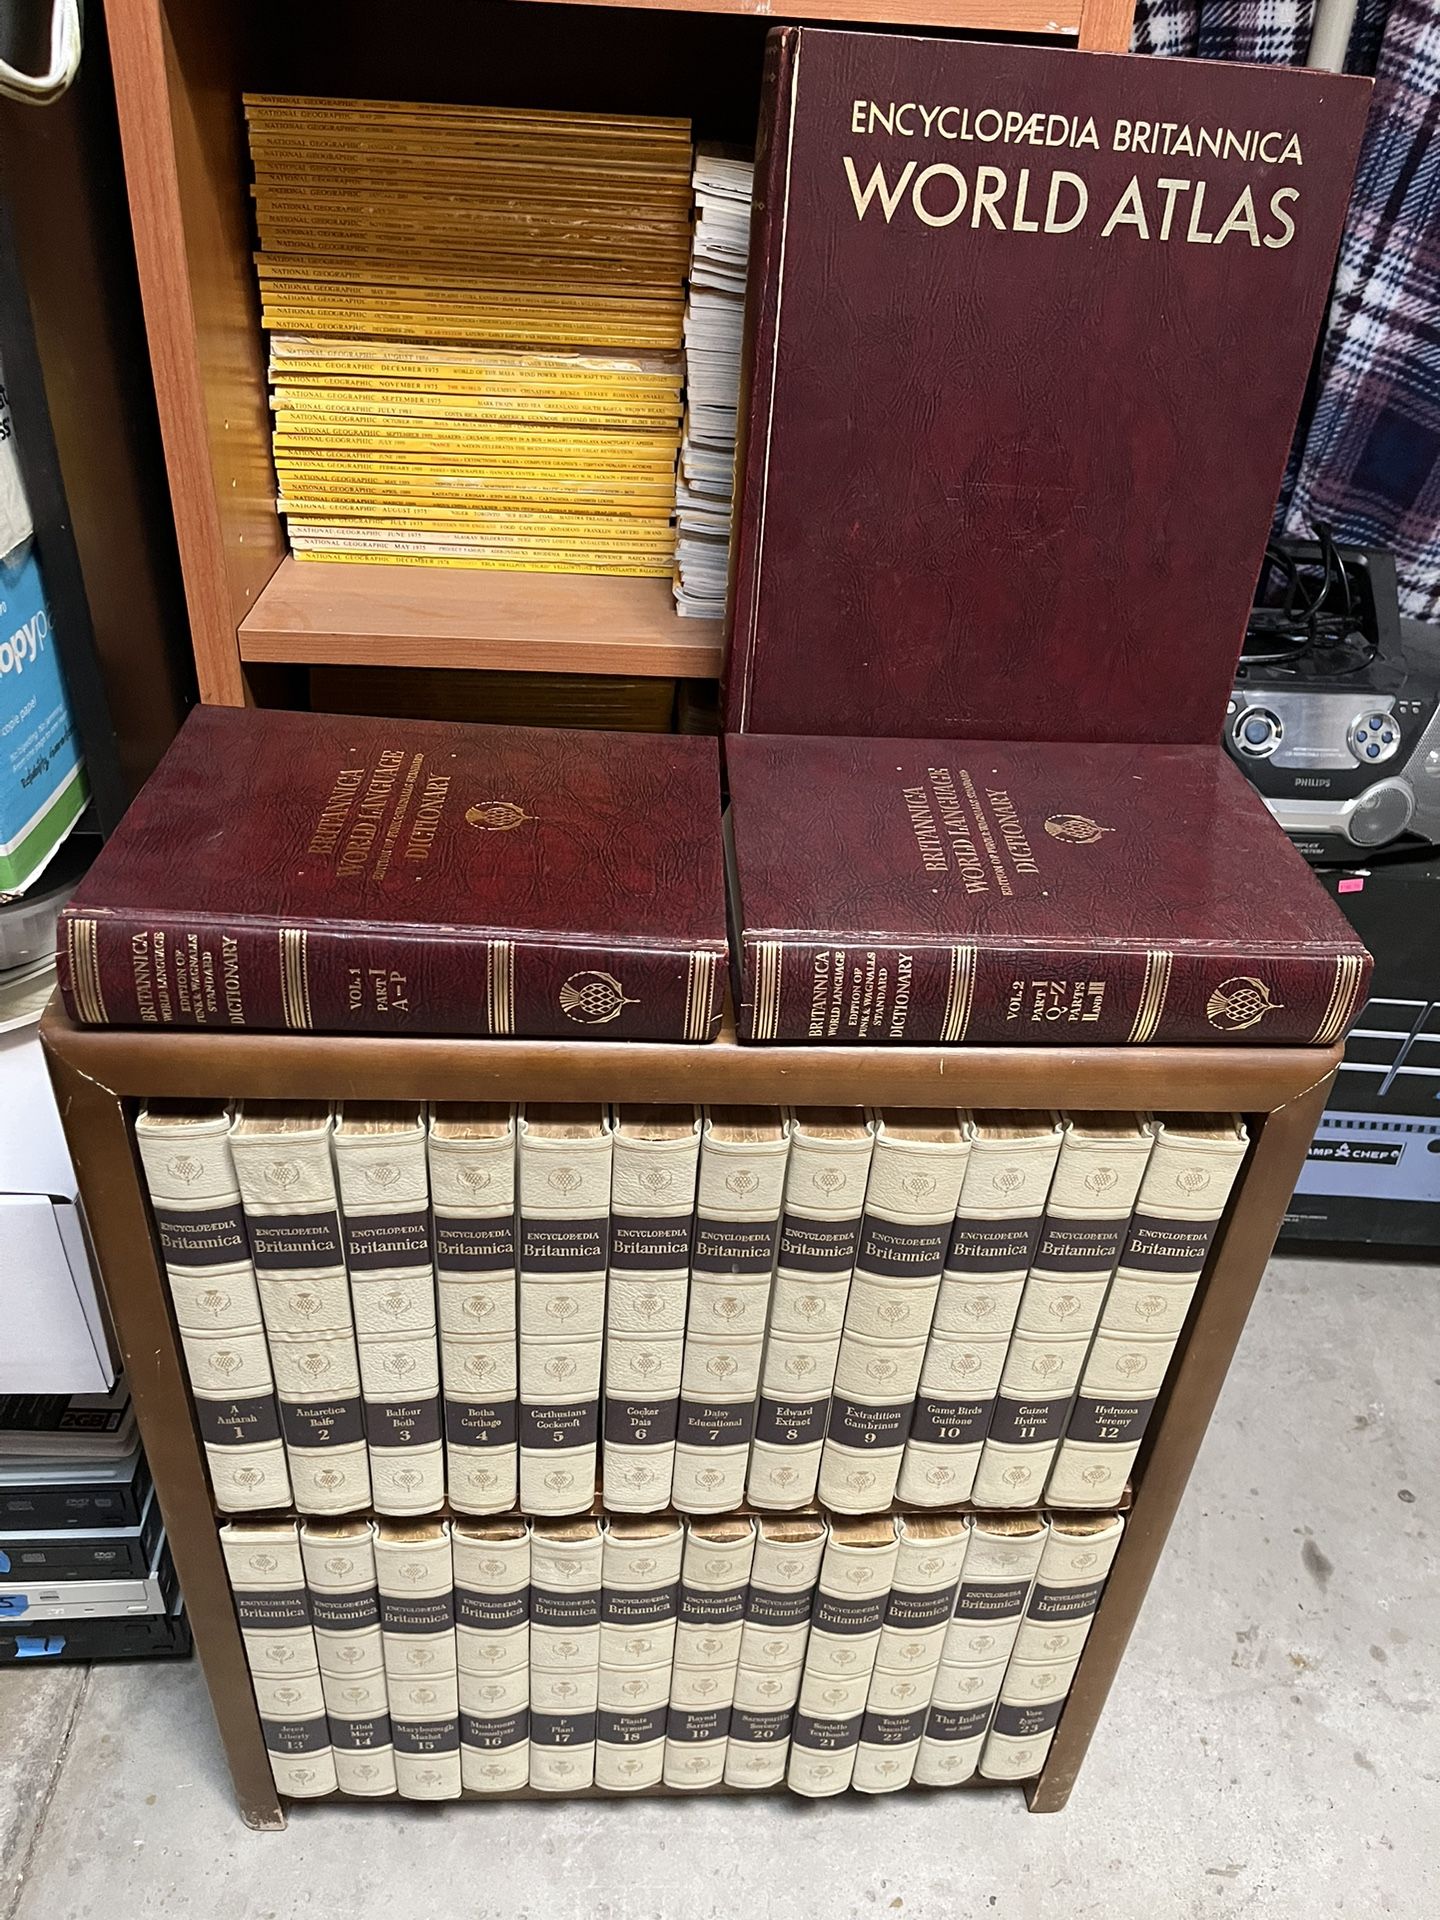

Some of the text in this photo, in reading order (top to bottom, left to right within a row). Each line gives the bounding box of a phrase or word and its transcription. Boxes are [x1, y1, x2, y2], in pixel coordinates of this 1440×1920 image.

[1112, 119, 1303, 165] BRITANNICA
[842, 156, 1300, 249] WORLD ATLAS
[283, 360, 320, 368] NATIONAL
[325, 362, 375, 371] GEOGRAPHIC
[381, 364, 422, 373] DECEMBER
[1295, 778, 1331, 788] PHILIPS
[308, 768, 365, 854] BRITANNICA
[335, 750, 405, 877] WORLD LANGUAGE
[404, 772, 451, 860] DICTIONARY
[902, 786, 949, 871] BRITANNICA
[928, 767, 989, 894] WORLD LANGUAGE
[985, 787, 1039, 874] DICTIONARY
[187, 934, 201, 992] WAGNALLS
[132, 931, 158, 1022] BRITANNICA
[153, 931, 172, 1022] WORLD LANGUAGE
[202, 951, 218, 1013] STANDARD
[222, 935, 245, 1024] DICTIONARY
[177, 968, 191, 1012] EDITION
[368, 968, 388, 1011] PART I
[808, 950, 830, 1037] BRITANNICA
[828, 950, 845, 1036] WORLD LANGUAGE
[858, 951, 876, 1037] FUNK & WAGNALLS
[889, 952, 913, 1038] DICTIONARY
[1087, 981, 1106, 996] III
[848, 967, 863, 1026] EDITION OF
[873, 967, 888, 1026] STANDARD
[1068, 981, 1086, 1022] PARTS
[1031, 989, 1046, 1021] PART
[1081, 1013, 1100, 1022] II
[1352, 1150, 1390, 1159] CHEF
[161, 1233, 242, 1249] Britannica
[255, 1239, 335, 1253] Britannica
[349, 1238, 428, 1254] Britannica
[614, 1240, 688, 1254] Britannica
[780, 1238, 853, 1257] Britannica
[437, 1241, 514, 1255] Britannica
[524, 1244, 601, 1257] Britannica
[696, 1243, 770, 1257] Britannica
[865, 1243, 940, 1261] Britannica
[954, 1243, 1027, 1256] Britannica
[1043, 1241, 1115, 1256] Britannica
[1130, 1240, 1205, 1258] Britannica
[296, 1408, 345, 1416] Antarctica
[386, 1408, 421, 1417] Balfour
[531, 1408, 586, 1418] Carthusians
[627, 1407, 659, 1415] Cocker
[704, 1409, 729, 1418] Daisy
[777, 1407, 812, 1416] Edward
[847, 1407, 900, 1420] Extradition
[928, 1405, 982, 1415] Game Birds
[1019, 1407, 1048, 1415] Guizot
[1095, 1406, 1138, 1415] Hydrozoa
[218, 1416, 257, 1424] Antarah
[310, 1418, 334, 1427] Balfe
[393, 1419, 414, 1427] Both
[462, 1418, 501, 1427] Carthago
[537, 1419, 580, 1428] Cockcroft
[631, 1418, 651, 1426] Dais
[688, 1418, 742, 1426] Educational
[775, 1418, 810, 1426] Extract
[845, 1418, 899, 1430] Gambrinus
[1014, 1417, 1047, 1425] Hydrox
[1096, 1416, 1131, 1426] Jeremy
[234, 1427, 244, 1438] 1
[319, 1430, 329, 1440] 2
[400, 1430, 410, 1440] 3
[476, 1431, 488, 1441] 4
[553, 1432, 564, 1442] 5
[635, 1429, 646, 1439] 6
[709, 1430, 718, 1440] 7
[787, 1430, 798, 1440] 8
[865, 1433, 876, 1444] 9
[938, 1427, 960, 1438] 10
[1019, 1427, 1036, 1438] 11
[1098, 1427, 1119, 1438] 12
[535, 1604, 597, 1617] Britannica
[608, 1602, 671, 1615] Britannica
[682, 1602, 743, 1614] Britannica
[750, 1604, 810, 1618] Britannica
[961, 1599, 1021, 1610] Britannica
[1038, 1598, 1096, 1612] Britannica
[239, 1608, 305, 1618] Britannica
[313, 1606, 377, 1620] Britannica
[384, 1612, 449, 1624] Britannica
[461, 1605, 524, 1620] Britannica
[819, 1610, 879, 1625] Britannica
[889, 1605, 949, 1619] Britannica
[936, 1712, 987, 1724] The Index
[691, 1730, 709, 1738] 19
[754, 1730, 774, 1738] 20
[1019, 1724, 1039, 1733] 23
[623, 1733, 640, 1741] 18
[883, 1733, 902, 1741] 22
